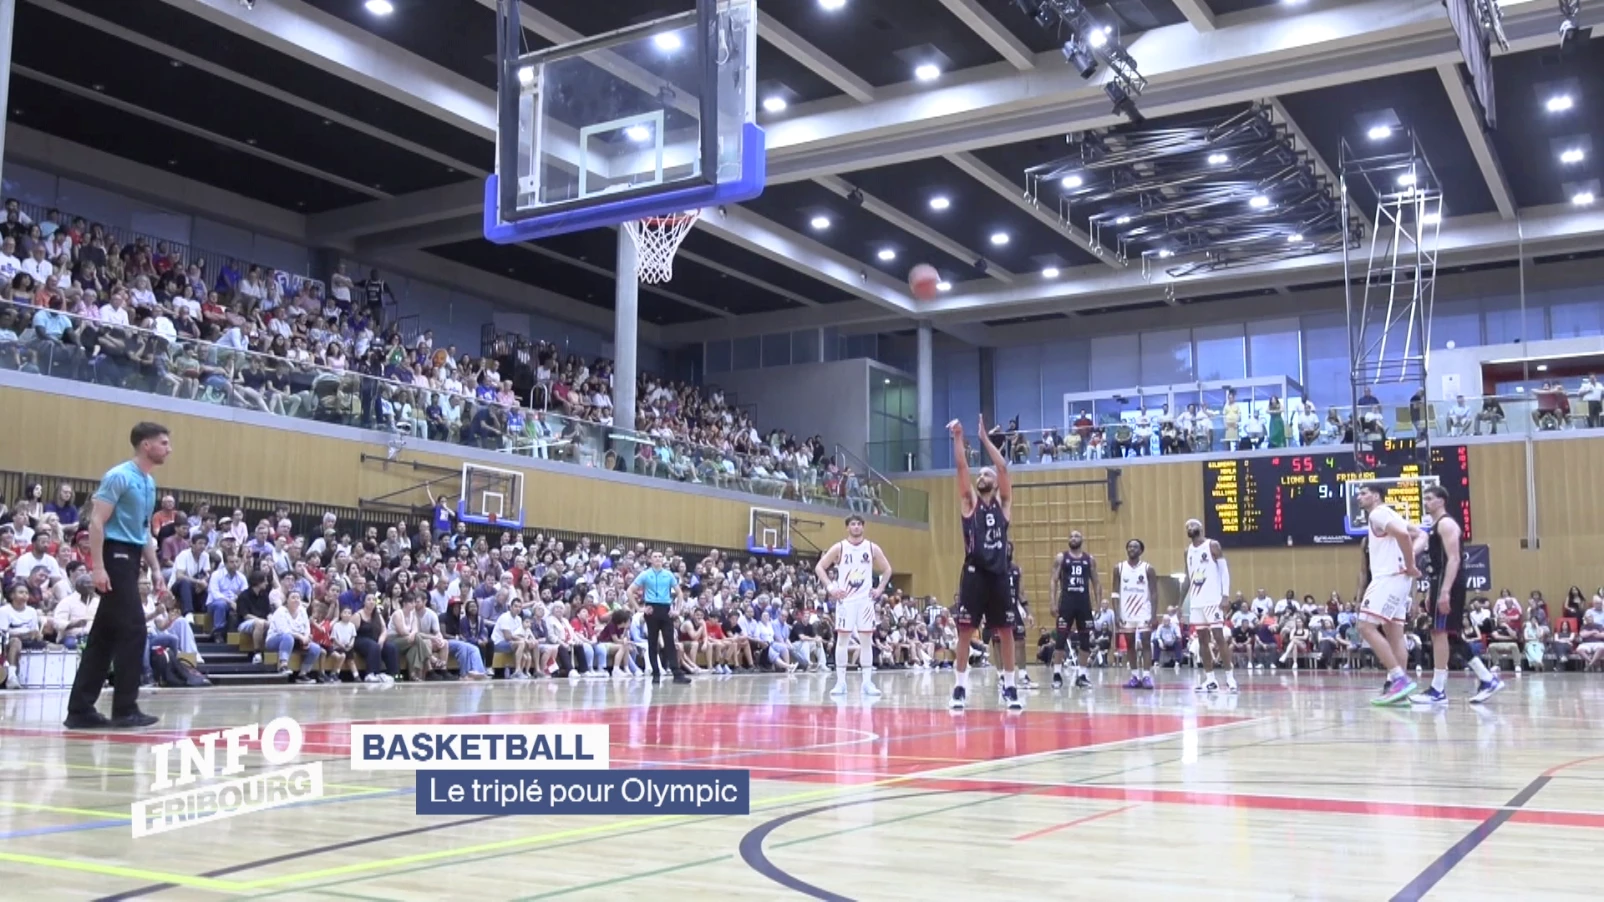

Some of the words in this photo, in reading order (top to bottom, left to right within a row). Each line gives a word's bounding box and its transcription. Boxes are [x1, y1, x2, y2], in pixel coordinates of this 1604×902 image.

[1292, 457, 1313, 471] 55
[1326, 457, 1334, 468] 4
[1281, 476, 1304, 484] LIONS
[844, 554, 852, 564] 21
[1071, 565, 1082, 575] 18
